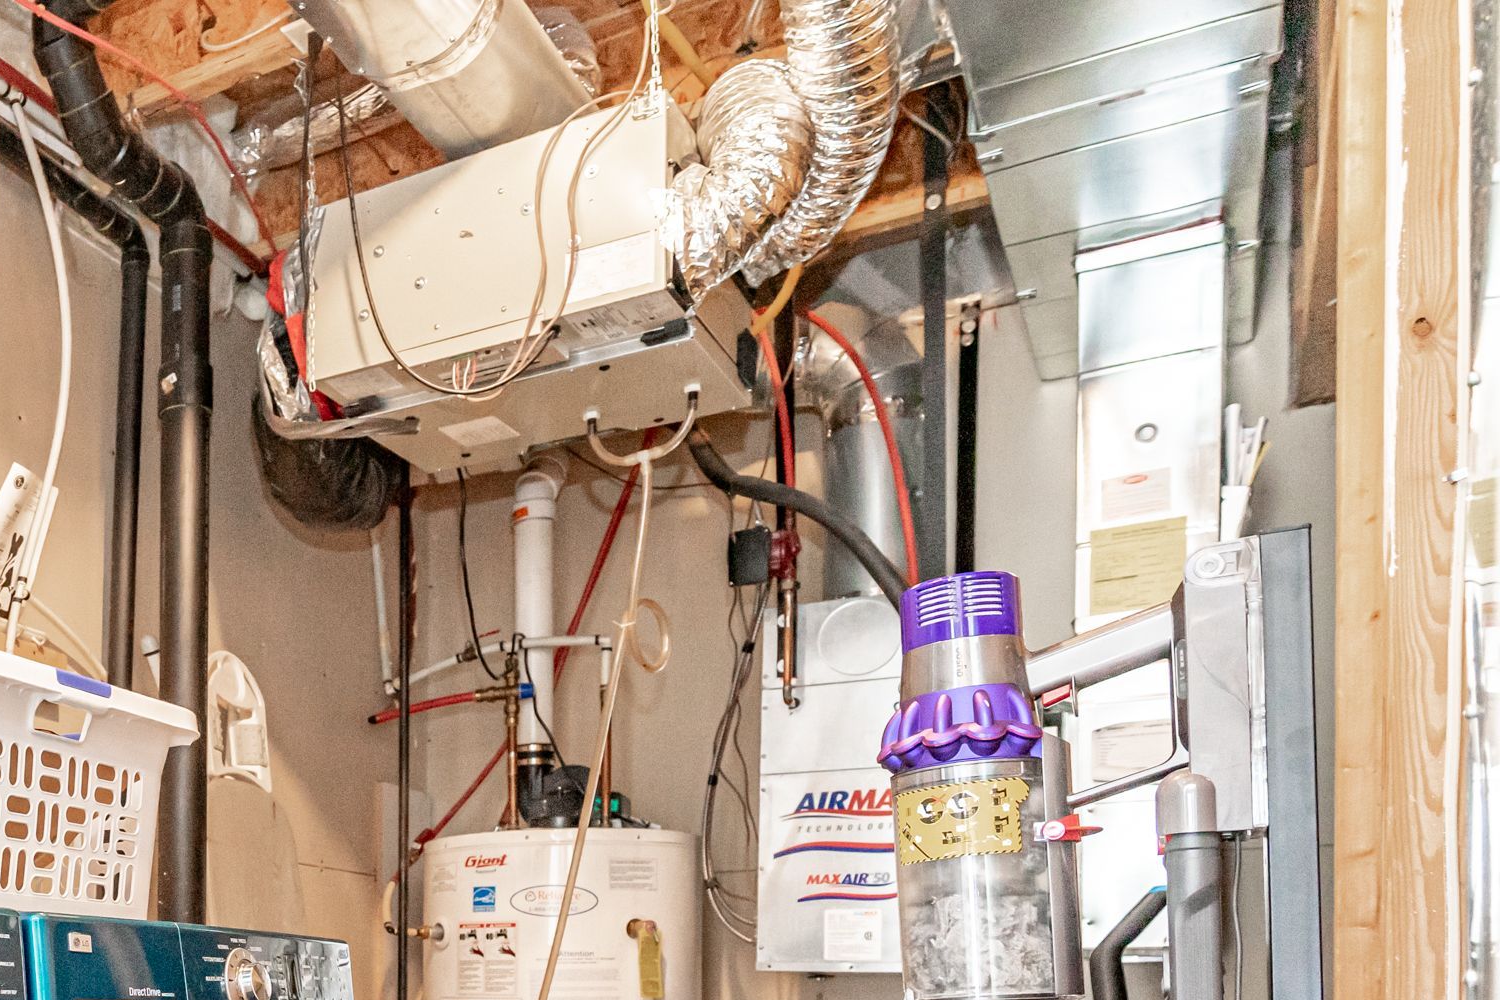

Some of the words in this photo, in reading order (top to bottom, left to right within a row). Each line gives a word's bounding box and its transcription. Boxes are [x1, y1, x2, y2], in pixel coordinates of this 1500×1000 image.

[795, 788, 893, 812] AIRMA
[797, 822, 892, 834] TECHNOLOGI
[464, 853, 507, 868] Giant
[873, 872, 891, 884] 50
[128, 987, 146, 997] Direct
[147, 987, 161, 997] Drive
